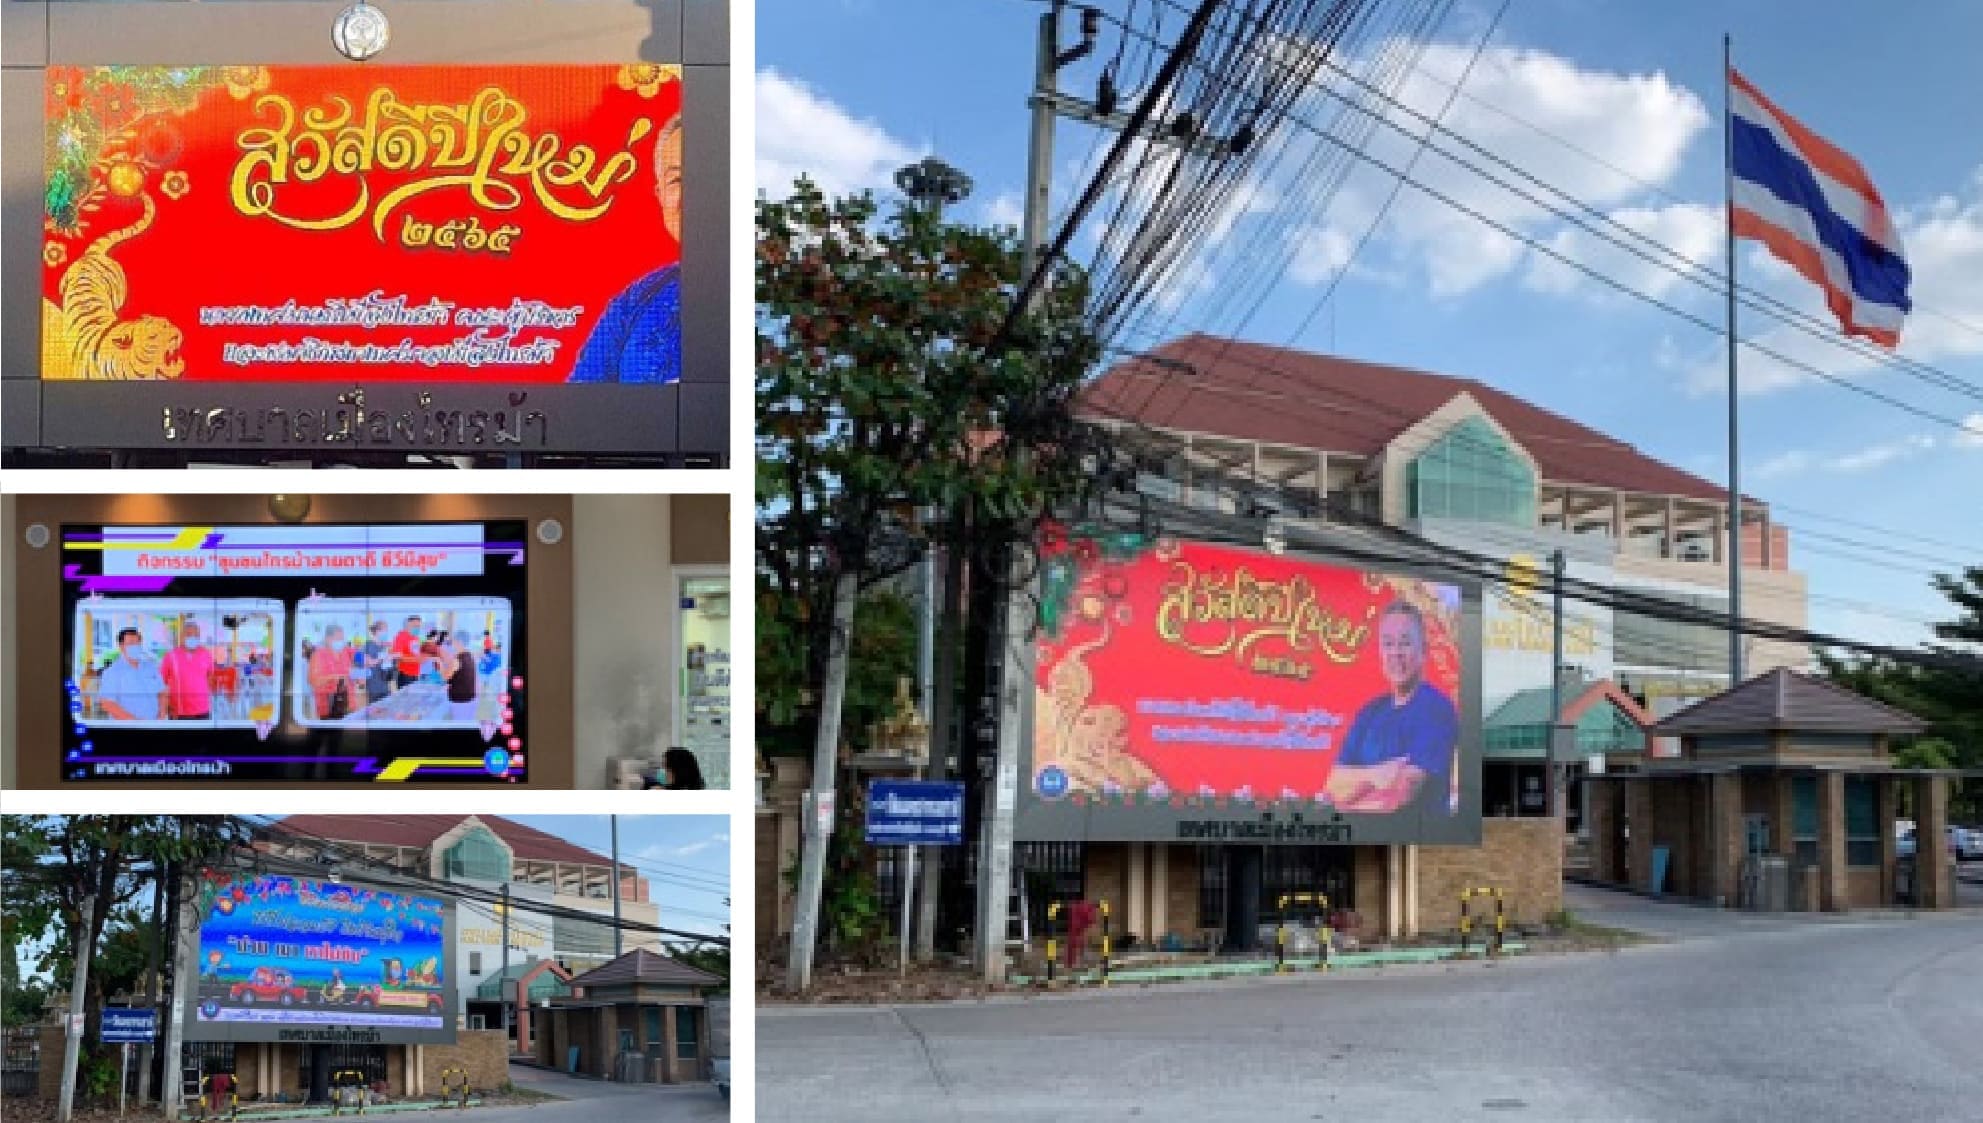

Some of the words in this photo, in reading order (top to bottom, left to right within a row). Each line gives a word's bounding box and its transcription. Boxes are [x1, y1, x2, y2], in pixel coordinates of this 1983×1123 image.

[230, 86, 652, 243] สวัสดีปีใหม่
[400, 213, 522, 254] ๒๕๖๕
[161, 387, 549, 445] เทศบาลเมืองไทรม้า
[137, 552, 205, 569] กิจกรรม
